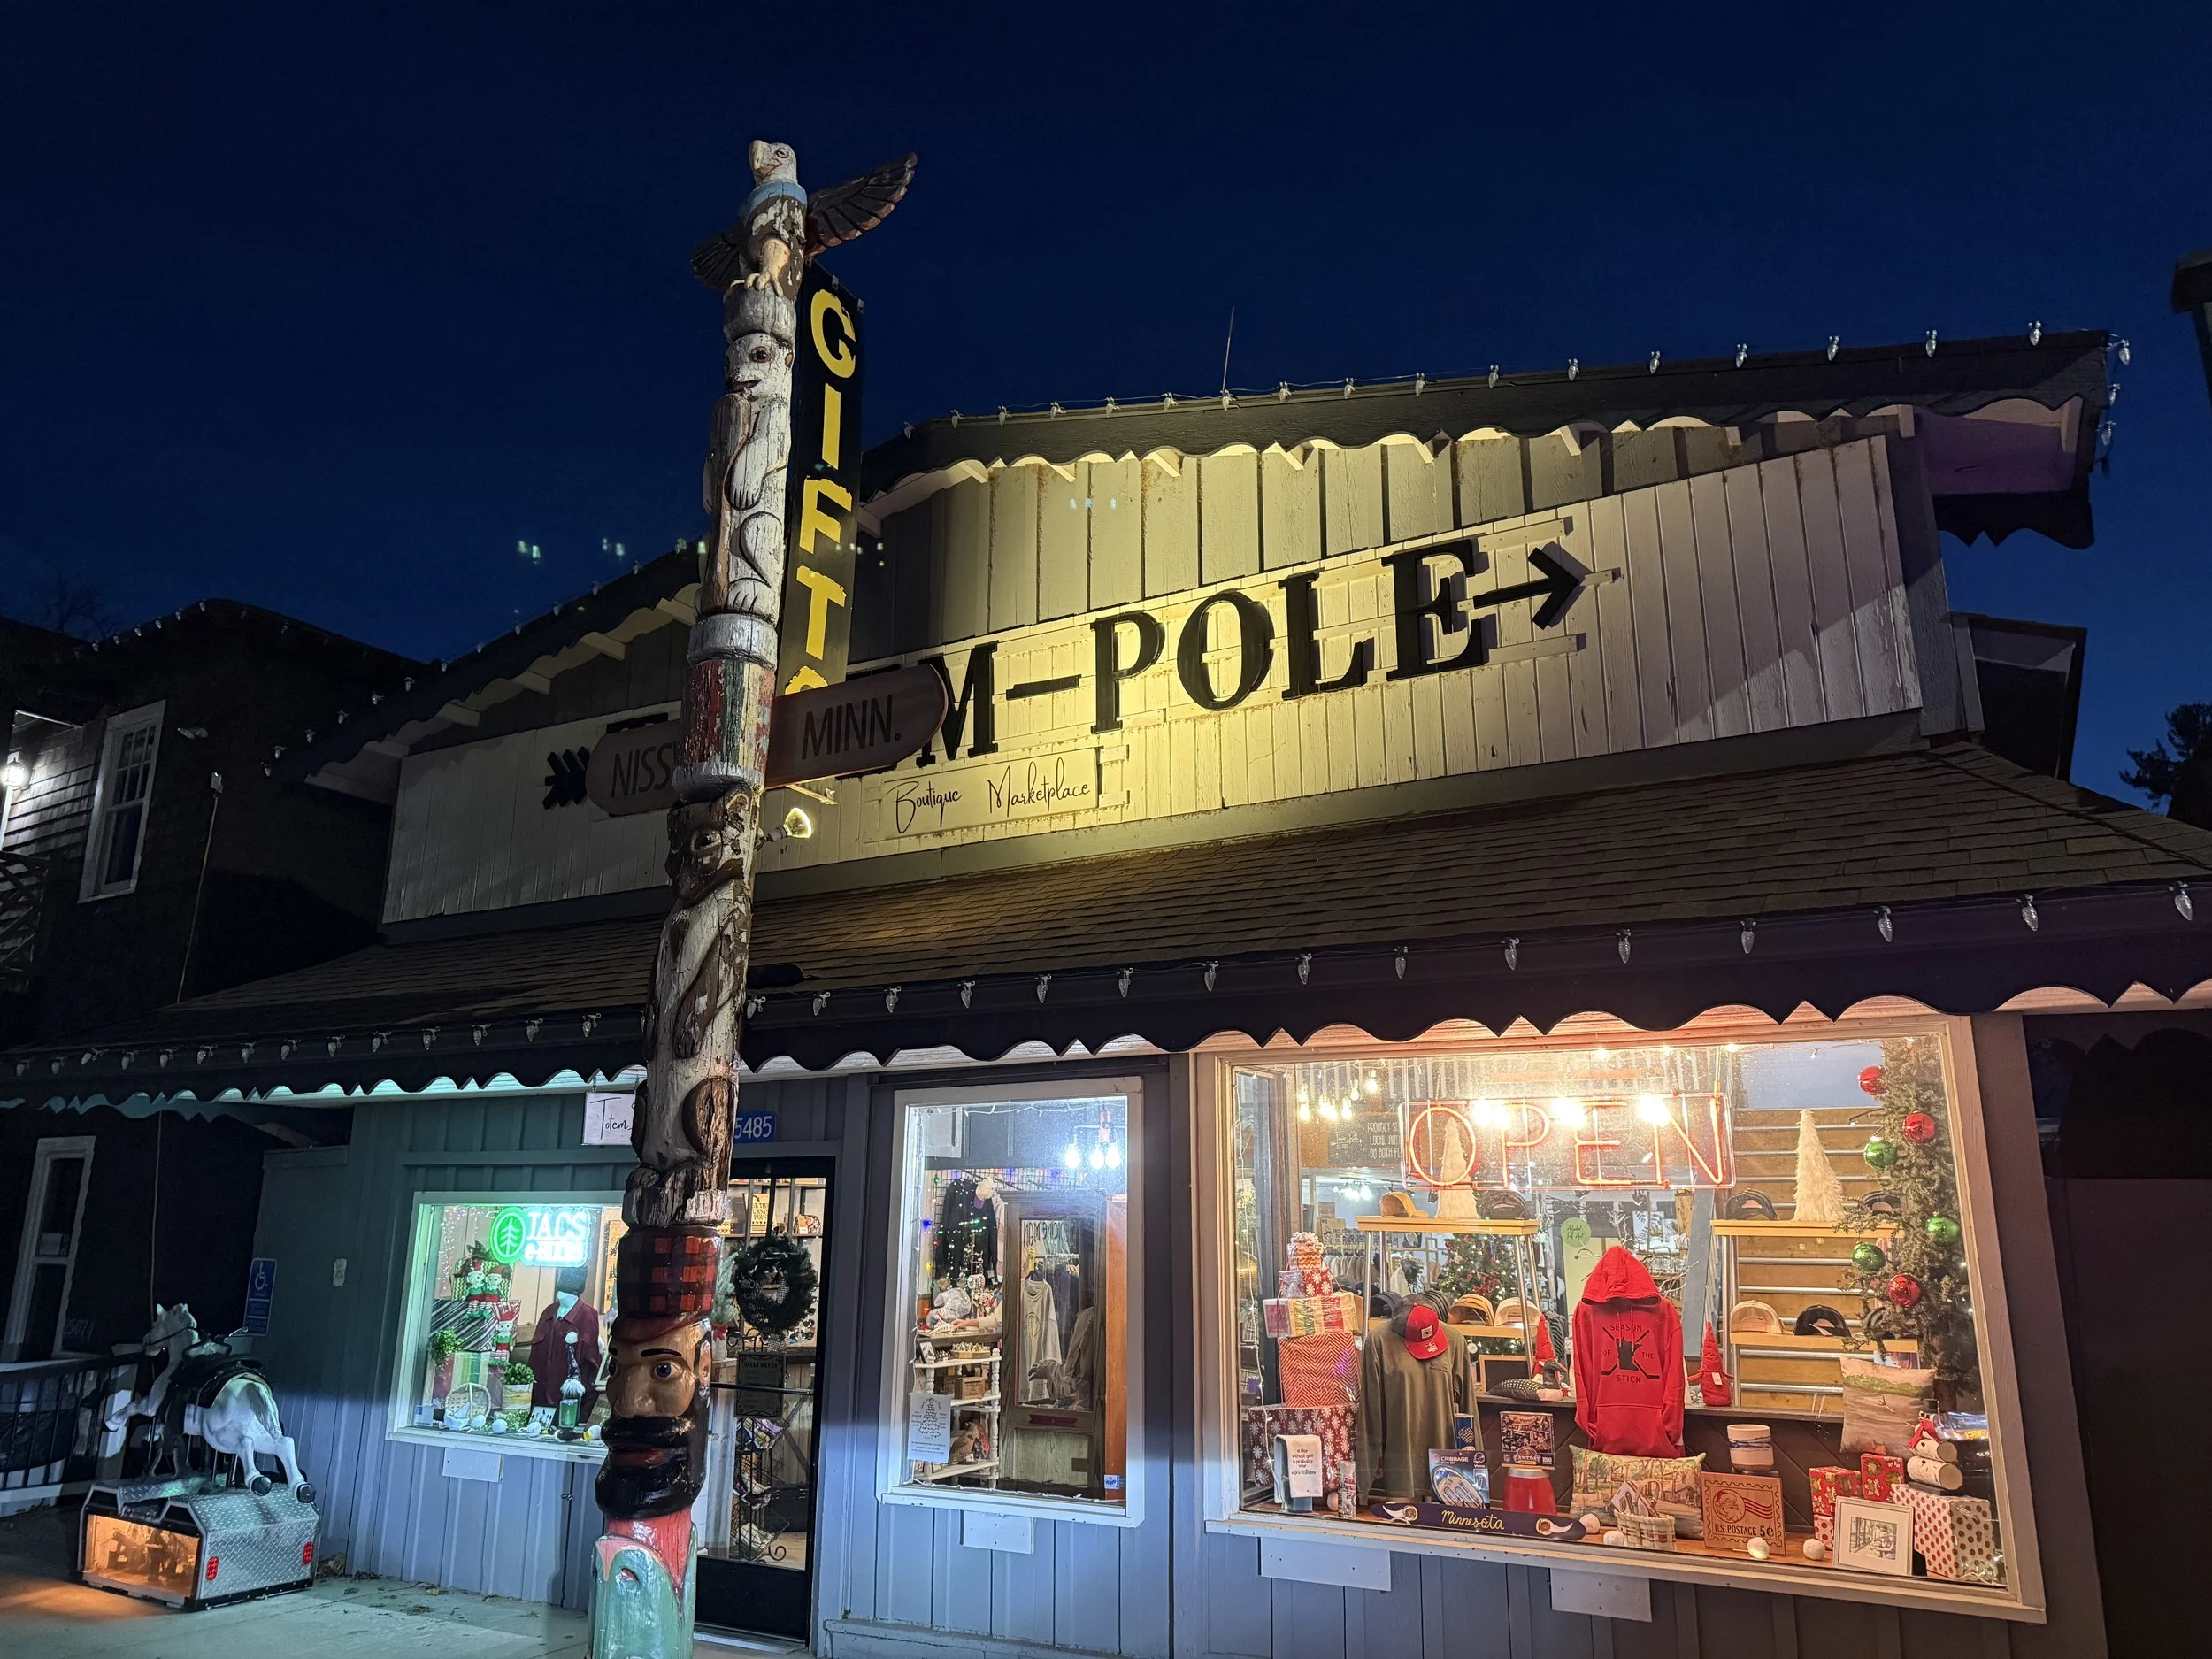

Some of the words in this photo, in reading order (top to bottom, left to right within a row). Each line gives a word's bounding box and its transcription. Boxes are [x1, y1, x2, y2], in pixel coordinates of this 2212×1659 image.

[802, 694, 902, 760] MINN.
[611, 741, 680, 798] NISS
[887, 780, 962, 834] Boutique
[987, 757, 1091, 818] Marketplace
[1409, 1099, 1723, 1187] OPEN
[526, 1211, 586, 1240] JACS
[1609, 1323, 1642, 1332] SEASON
[1617, 1374, 1641, 1384] STICK
[1440, 1509, 1506, 1532] Minnesota
[1714, 1523, 1726, 1533] U.S.
[1726, 1525, 1757, 1536] POSTAGE
[1759, 1525, 1775, 1538] 5¢
